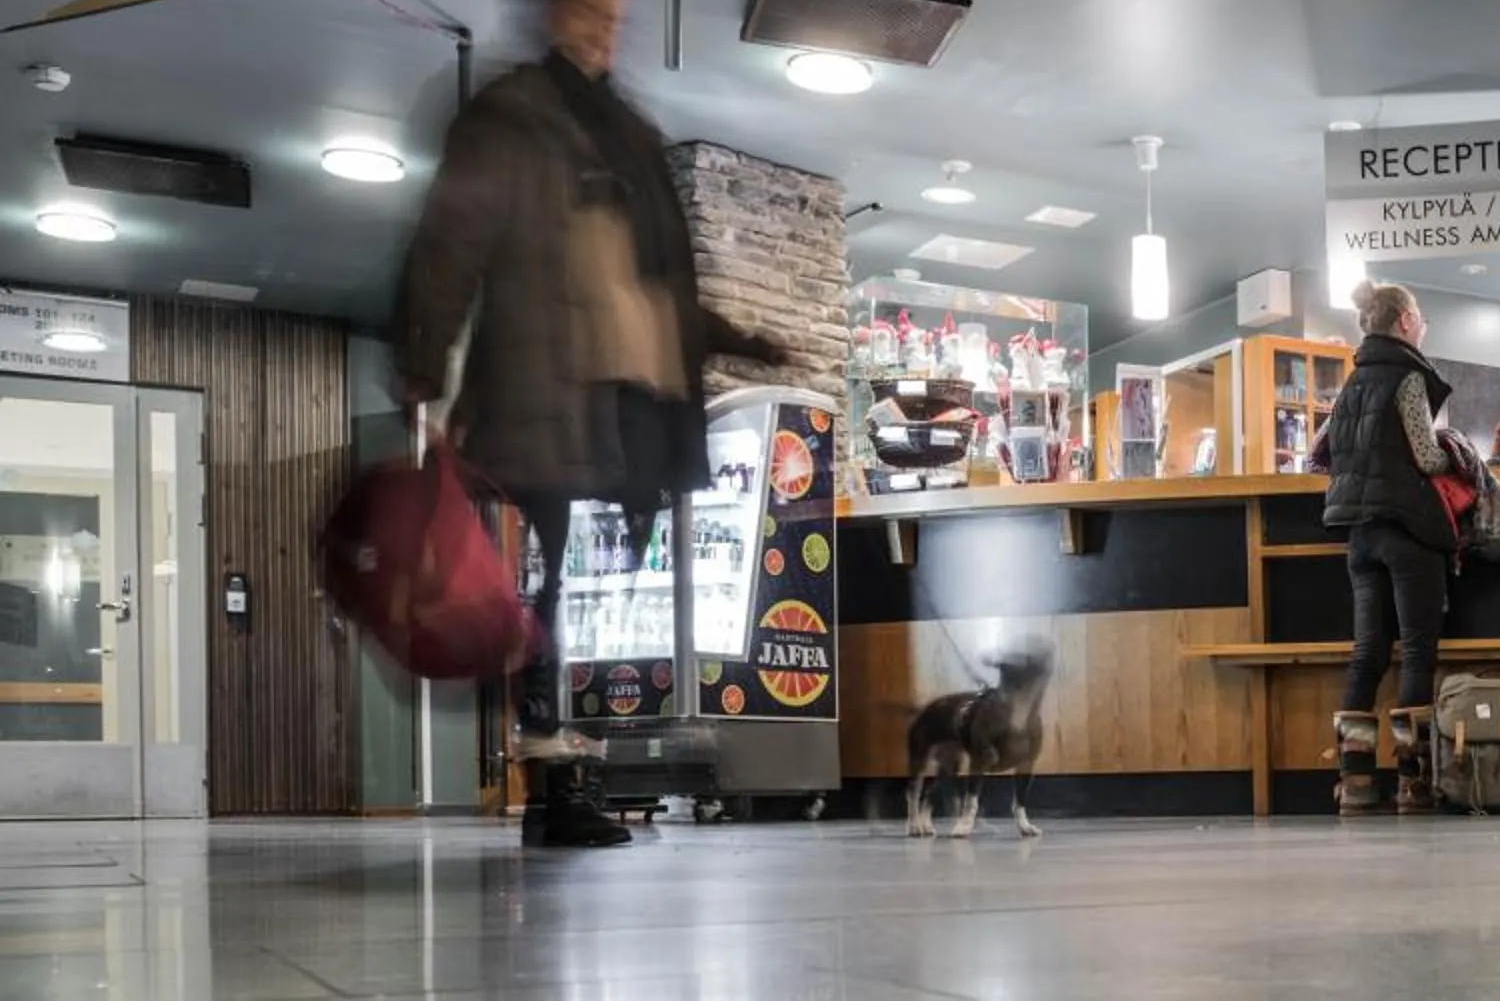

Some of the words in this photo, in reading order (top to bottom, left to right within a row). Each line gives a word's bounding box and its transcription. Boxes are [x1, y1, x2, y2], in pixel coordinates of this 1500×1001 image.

[1383, 192, 1476, 221] KYLPYLÄ
[1486, 195, 1497, 217] /
[1345, 226, 1460, 250] WELLNESS
[757, 642, 829, 668] JAFFA
